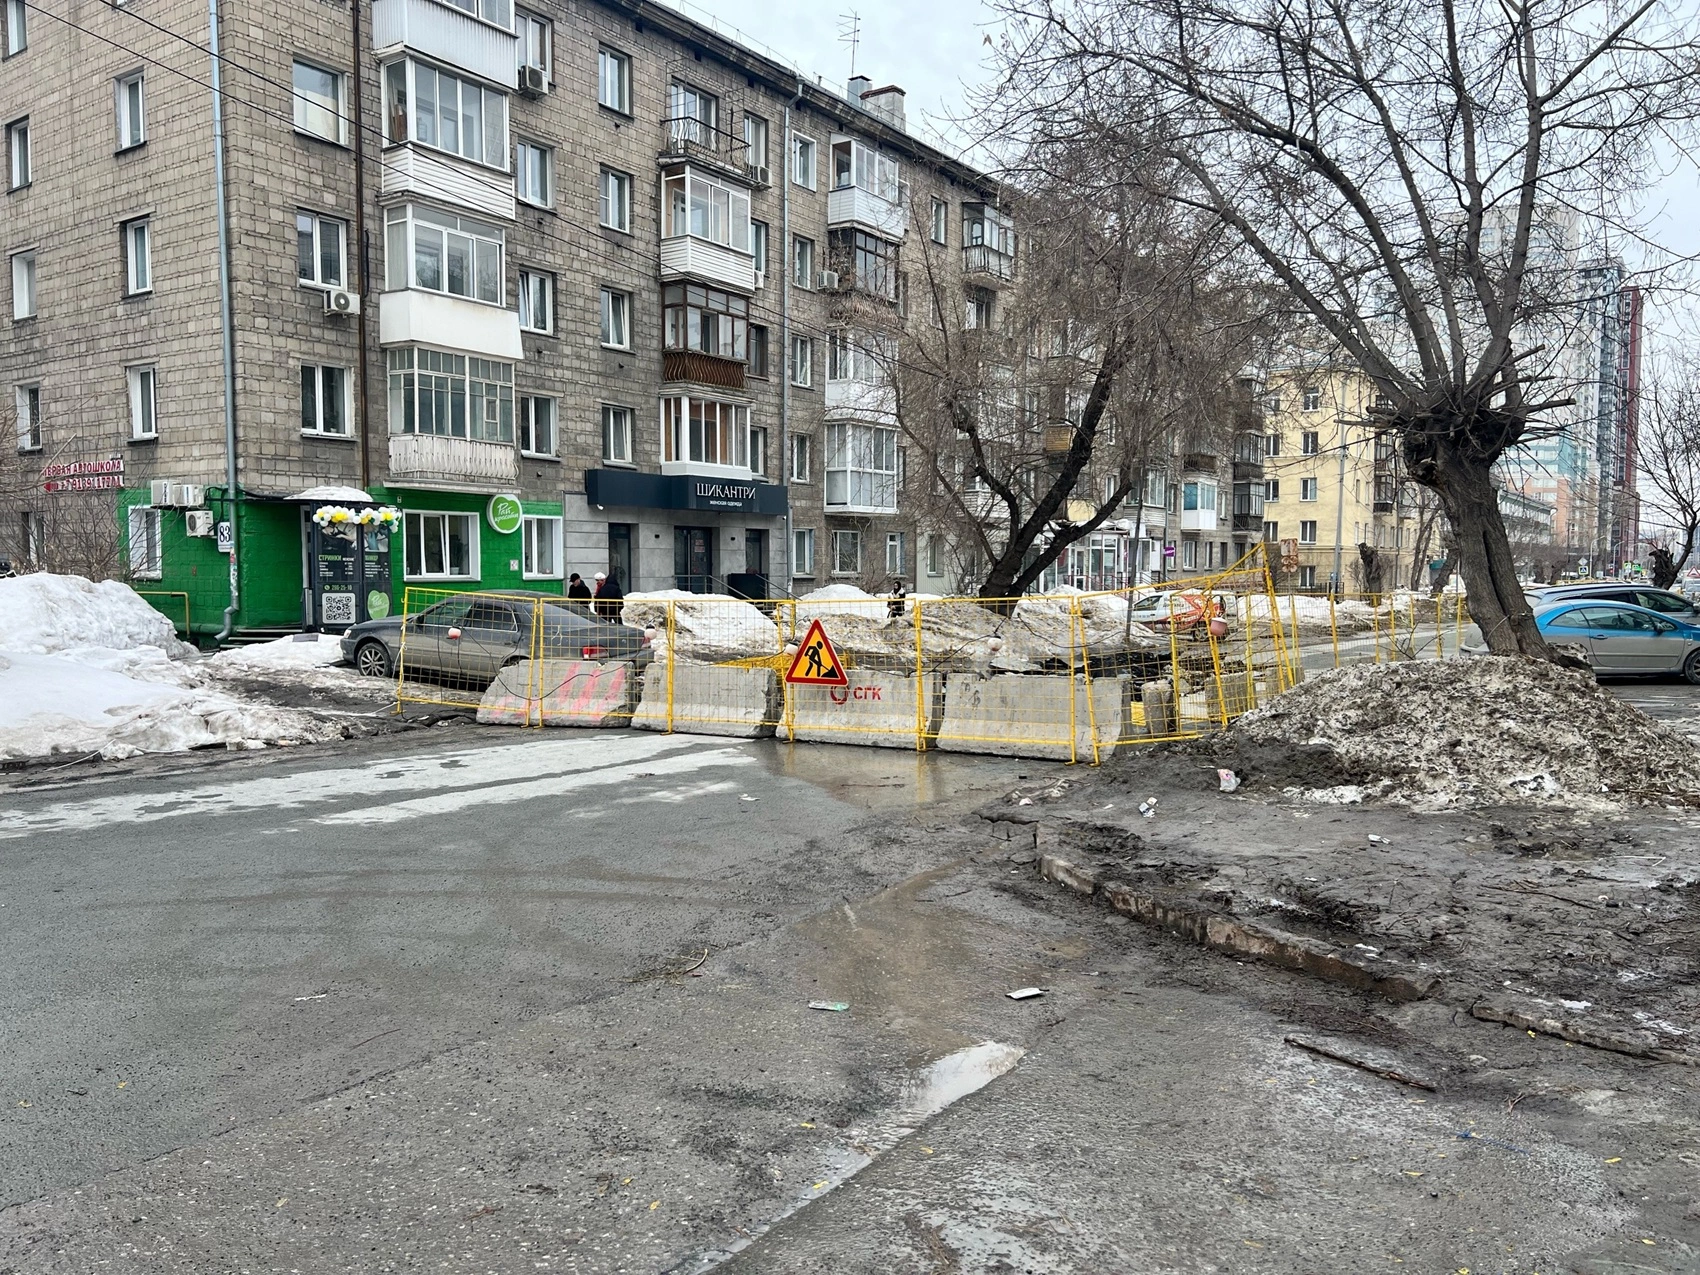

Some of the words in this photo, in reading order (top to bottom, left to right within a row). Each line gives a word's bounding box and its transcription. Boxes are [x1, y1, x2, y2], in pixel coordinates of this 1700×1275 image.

[697, 483, 756, 499] ШИКАНТРИ
[219, 525, 231, 543] 83
[853, 686, 882, 701] СГК
